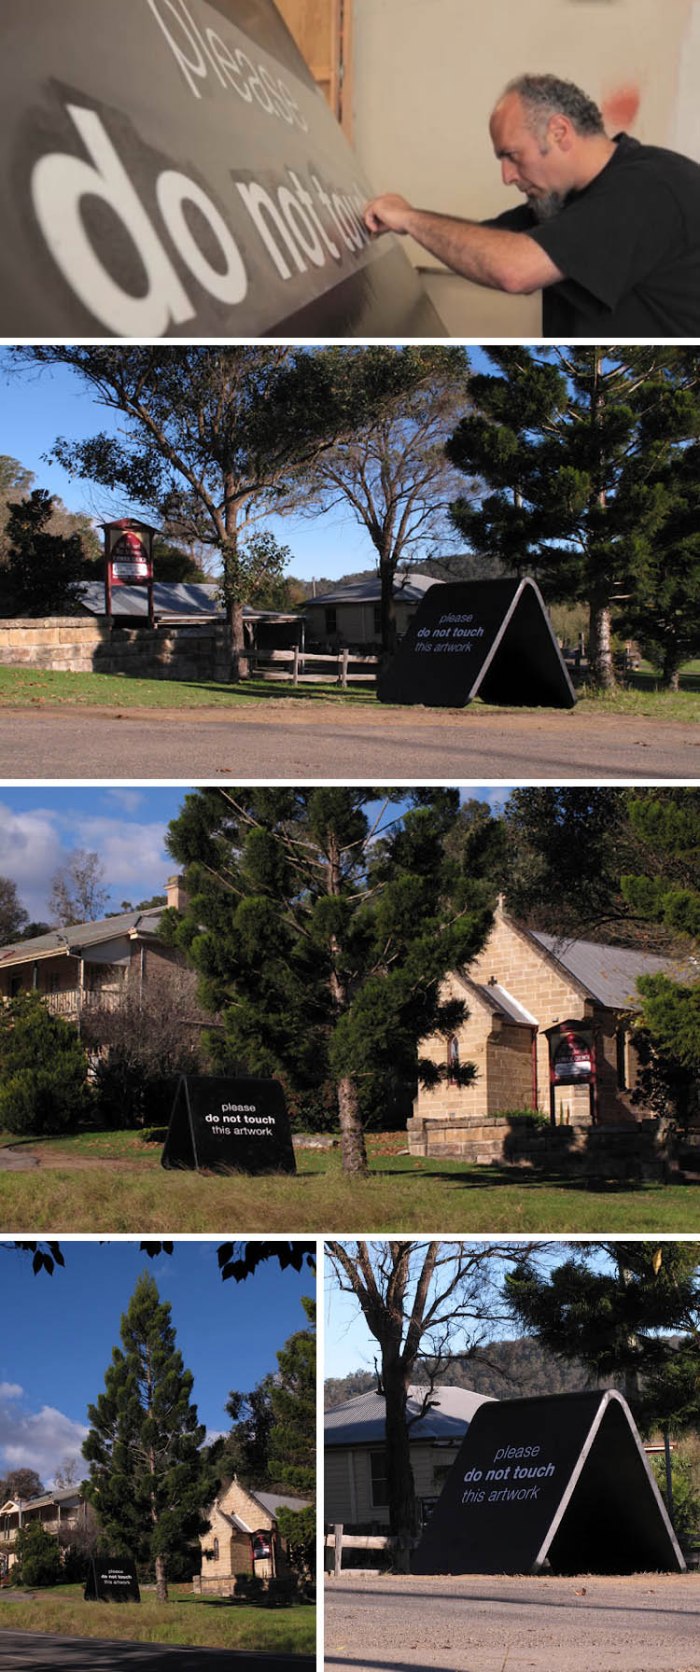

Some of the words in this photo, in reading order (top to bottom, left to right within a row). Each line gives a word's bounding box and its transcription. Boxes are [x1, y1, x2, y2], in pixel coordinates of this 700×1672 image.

[31, 103, 248, 338] do
[235, 169, 341, 281] not
[439, 612, 474, 624] please
[417, 627, 431, 637] do
[432, 628, 452, 637] not
[452, 627, 485, 637] touch
[415, 642, 433, 652] this
[433, 642, 473, 652] artwork
[221, 1102, 256, 1112] please
[205, 1113, 220, 1123] do
[222, 1115, 242, 1123] not
[243, 1115, 276, 1125] touch
[211, 1125, 231, 1135] this
[233, 1126, 273, 1136] artwork
[492, 1444, 541, 1464] please
[463, 1468, 483, 1482] do
[485, 1465, 511, 1481] not
[512, 1462, 556, 1479] touch
[461, 1488, 486, 1504] this
[487, 1485, 541, 1502] artwork
